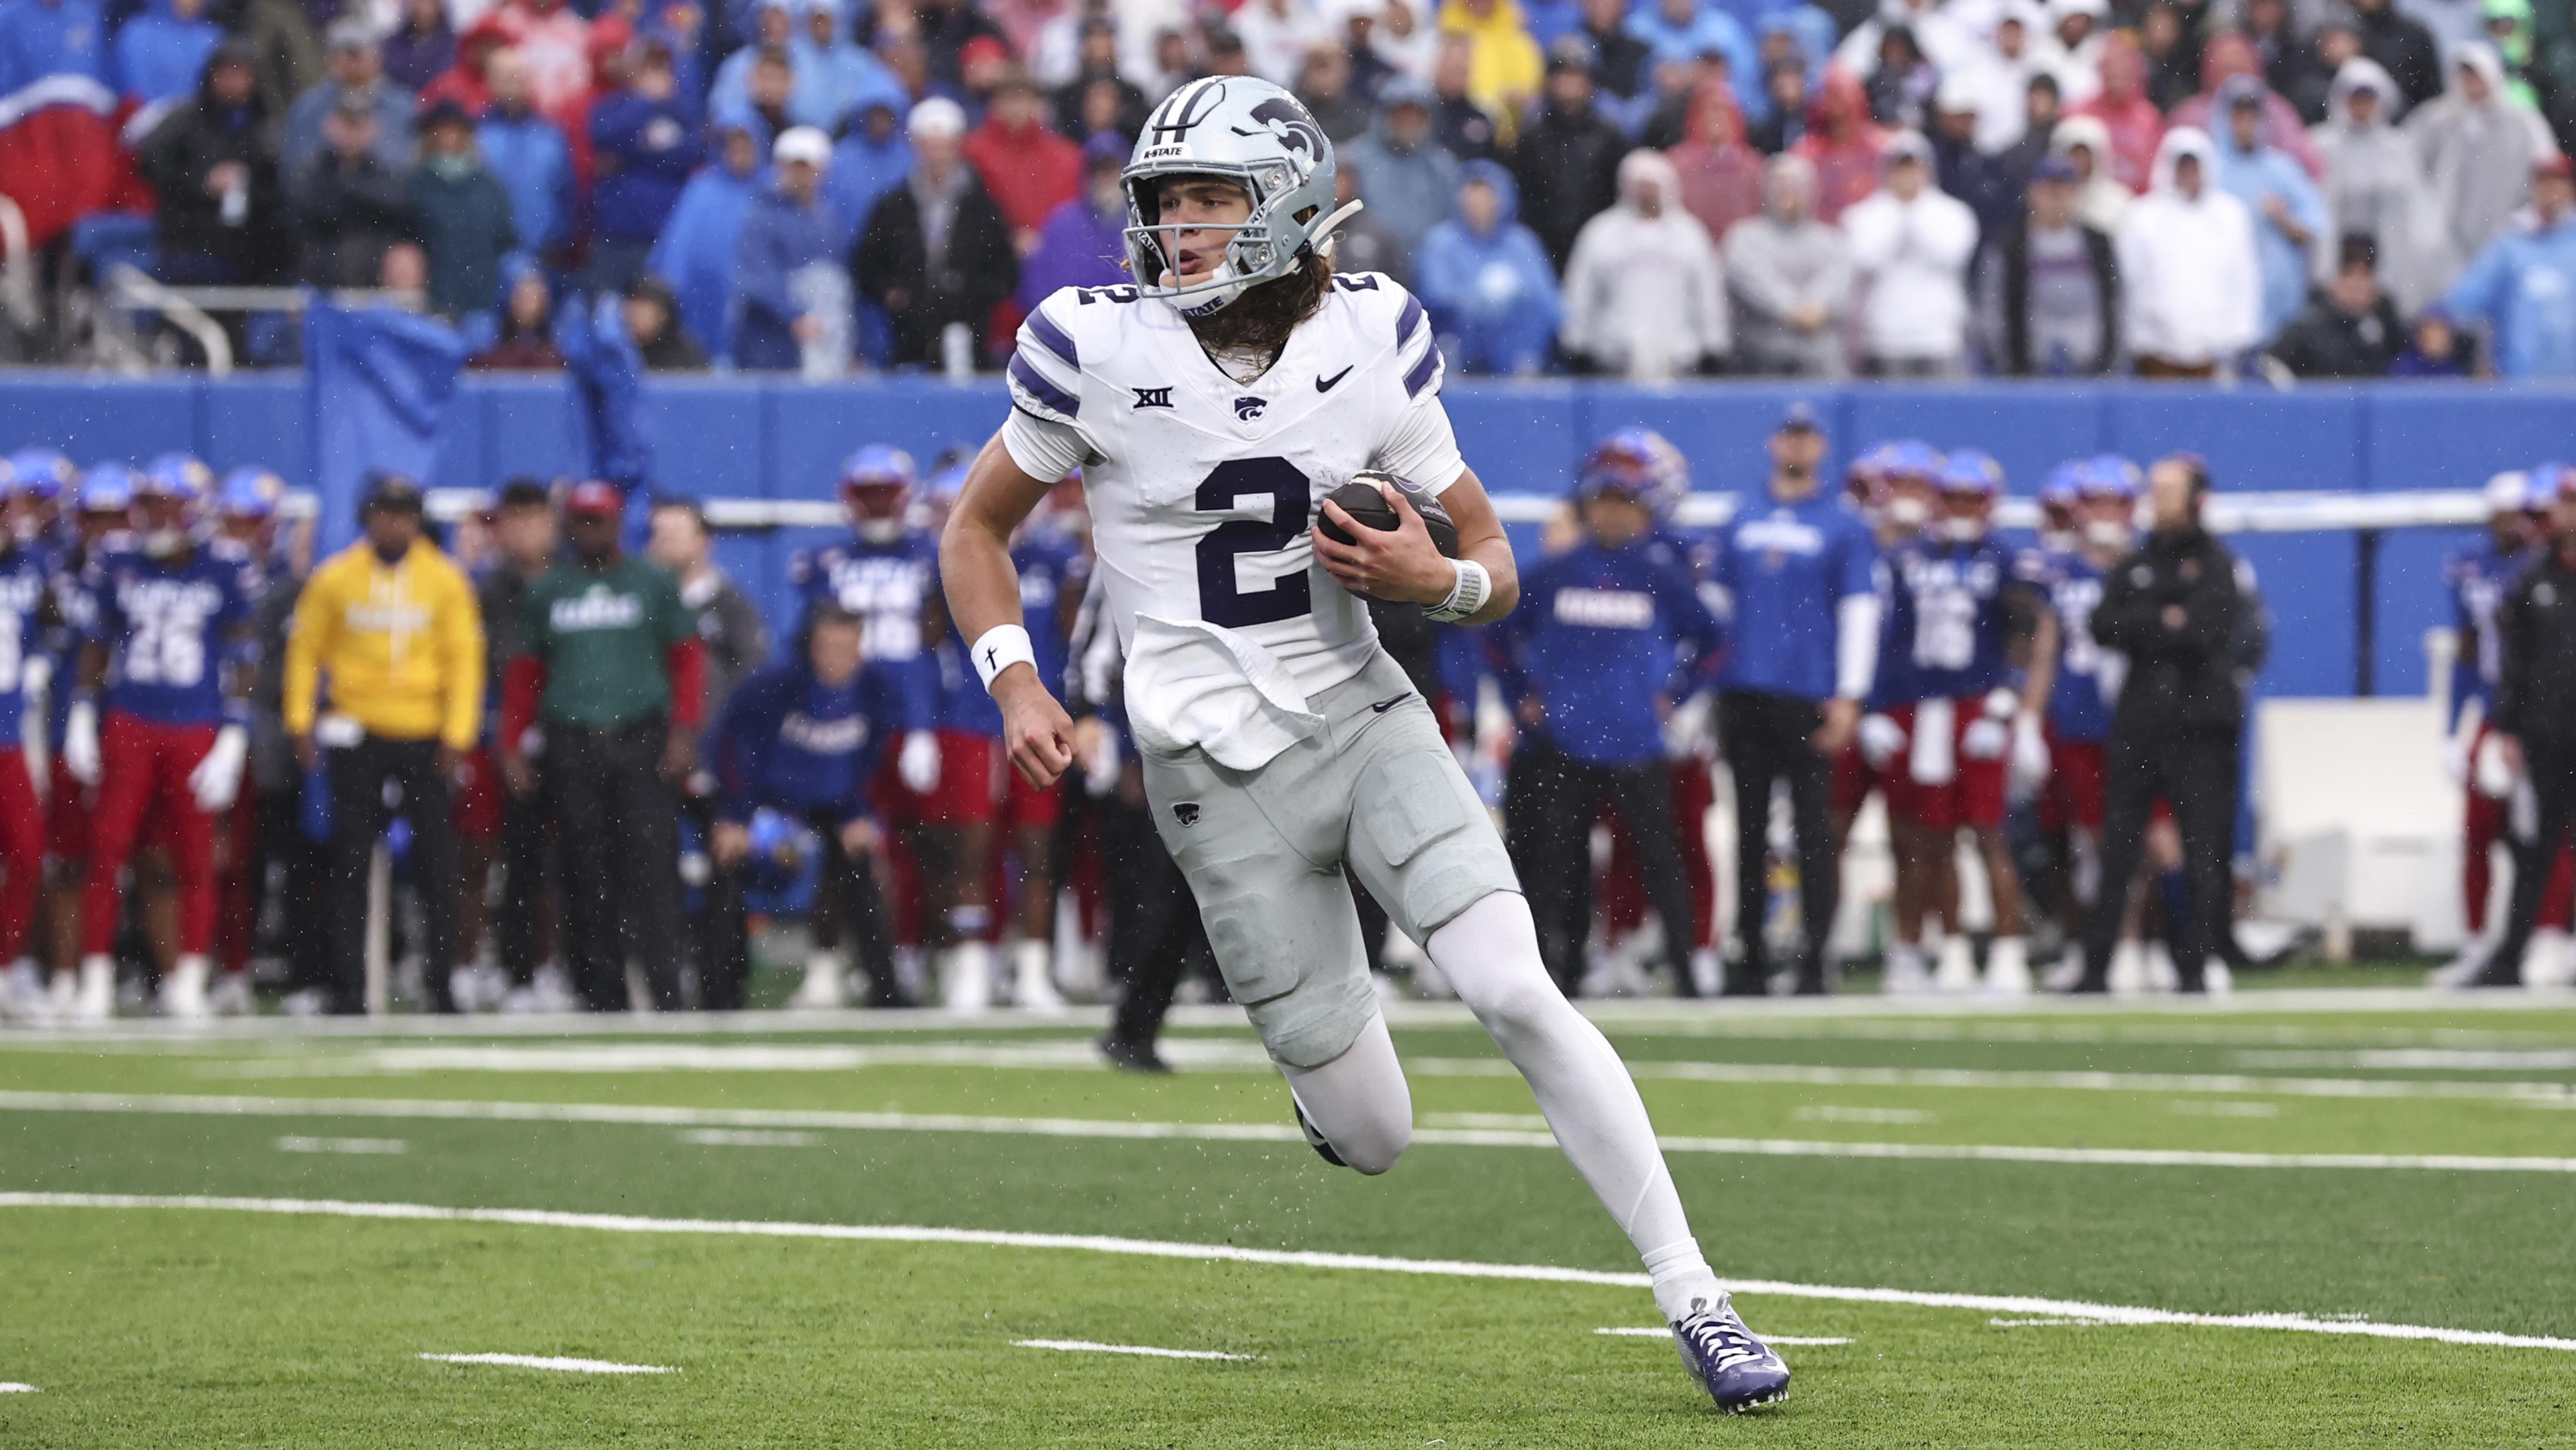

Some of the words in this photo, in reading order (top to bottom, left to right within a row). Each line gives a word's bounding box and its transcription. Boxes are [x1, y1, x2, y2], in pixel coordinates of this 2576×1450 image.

[1144, 147, 1183, 159] K-STATE
[1076, 286, 1140, 305] 2
[1131, 386, 1174, 409] XII
[1195, 456, 1312, 629] 2
